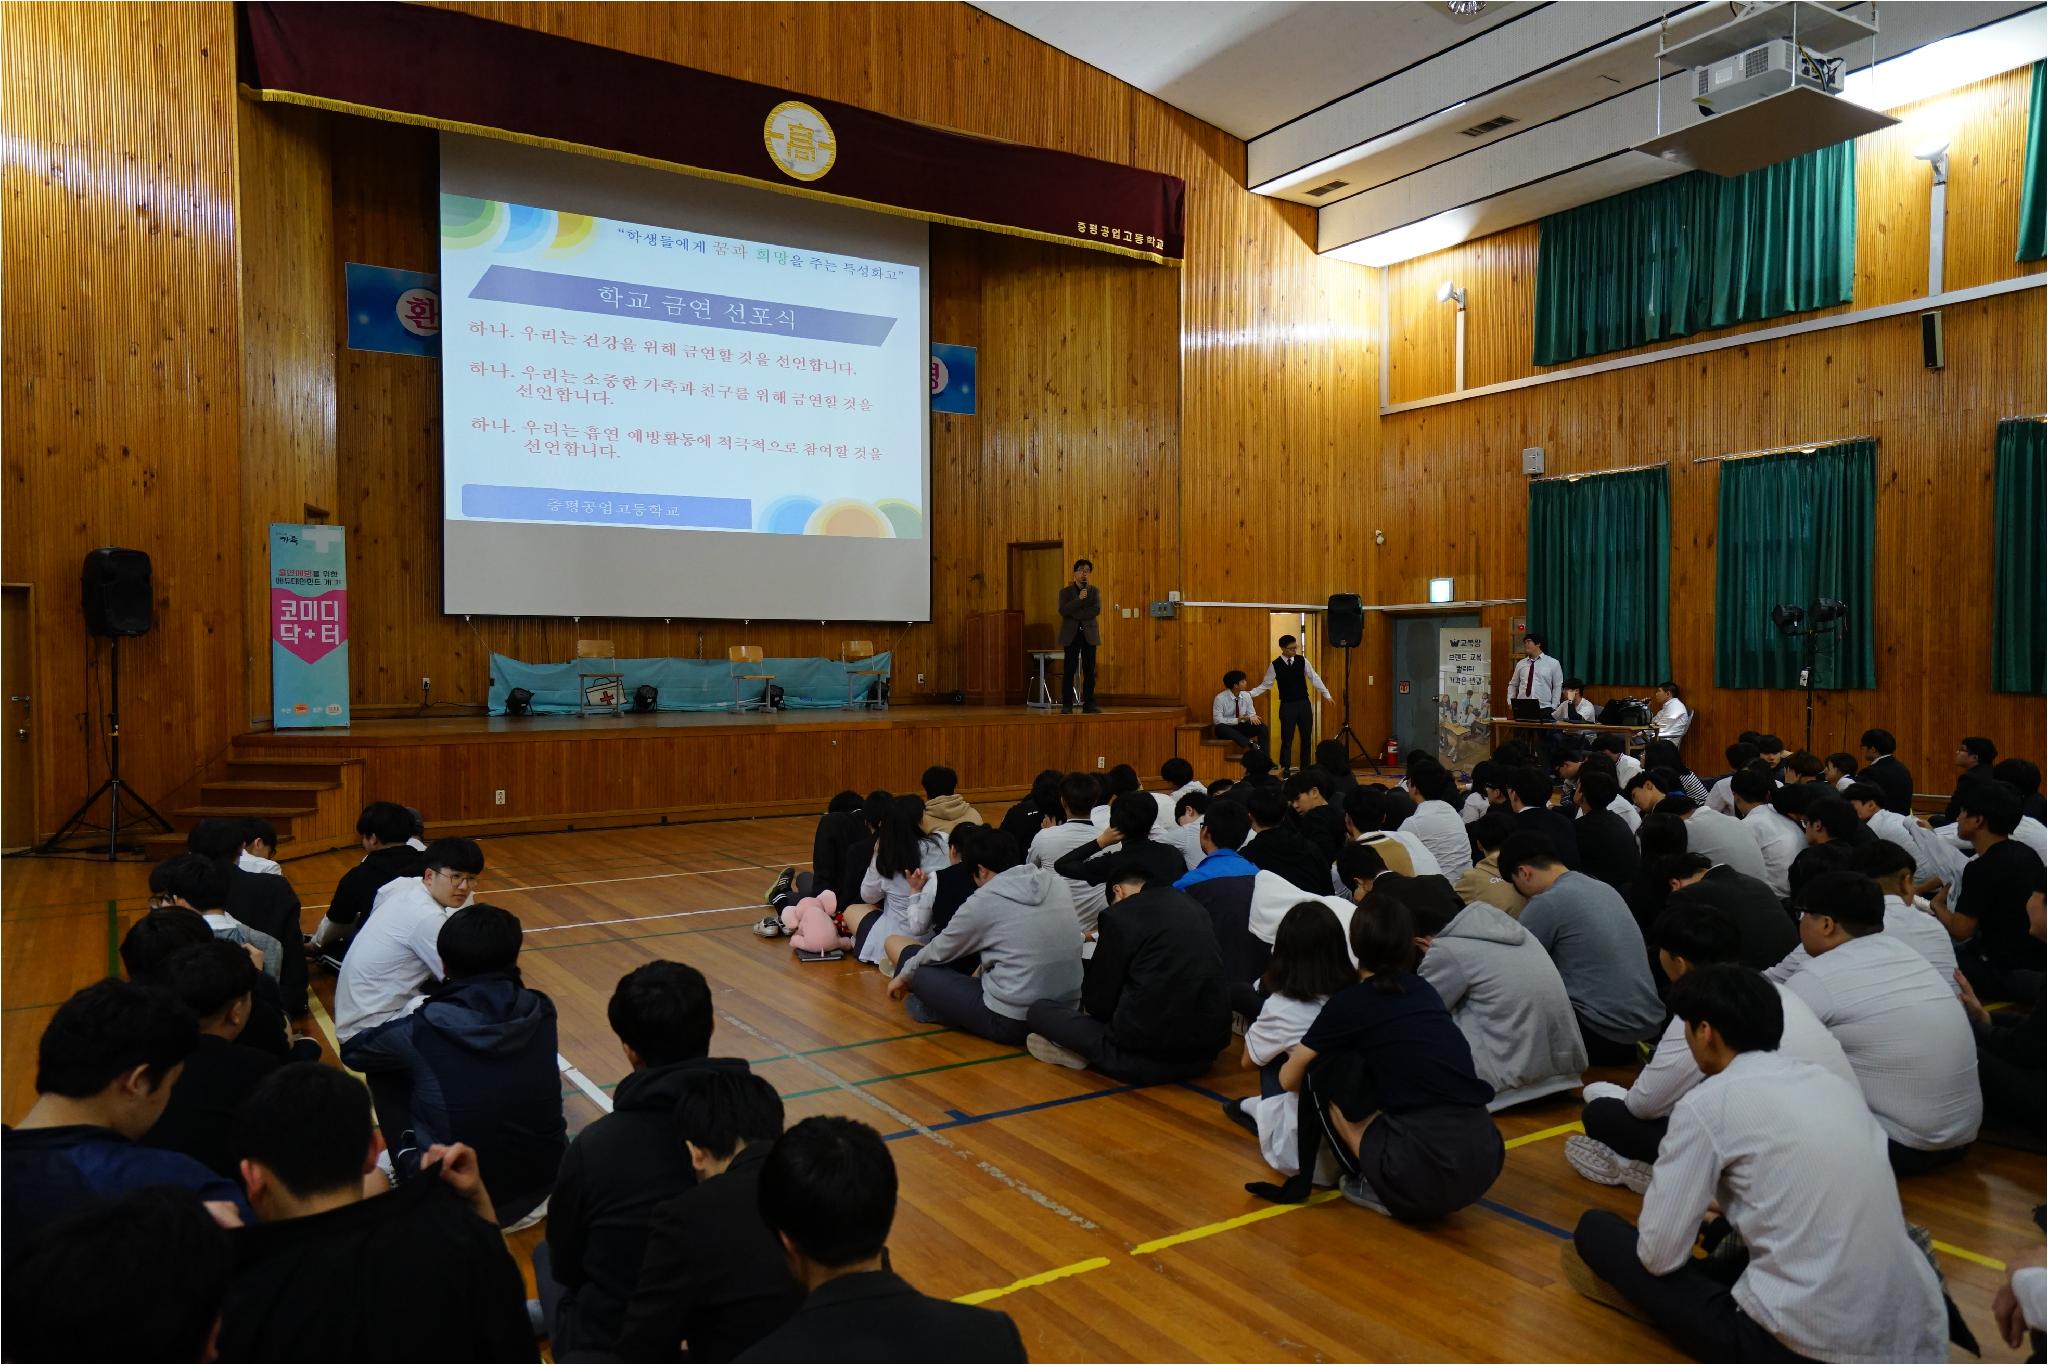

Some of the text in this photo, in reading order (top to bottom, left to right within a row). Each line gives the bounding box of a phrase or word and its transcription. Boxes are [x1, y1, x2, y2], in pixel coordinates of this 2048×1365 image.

[712, 241, 748, 260] 꿈과
[756, 248, 803, 268] 희망을
[809, 256, 837, 273] 주는
[597, 286, 796, 331] 학교 금연 선포식
[468, 319, 857, 376] 하나. 우리는 건강을 위해 금연할 것을 선언합니다.
[470, 360, 873, 412] 하나. 우리는 소중한 가족과 친구를 위해 금연할 것을
[471, 416, 883, 462] 하나. 우리는 흡연 예방활동에 적극적으로 참여할 것을
[523, 438, 621, 459] 선언합니다.
[546, 497, 680, 518] 증평공업고등학교
[280, 599, 339, 622] 코미디
